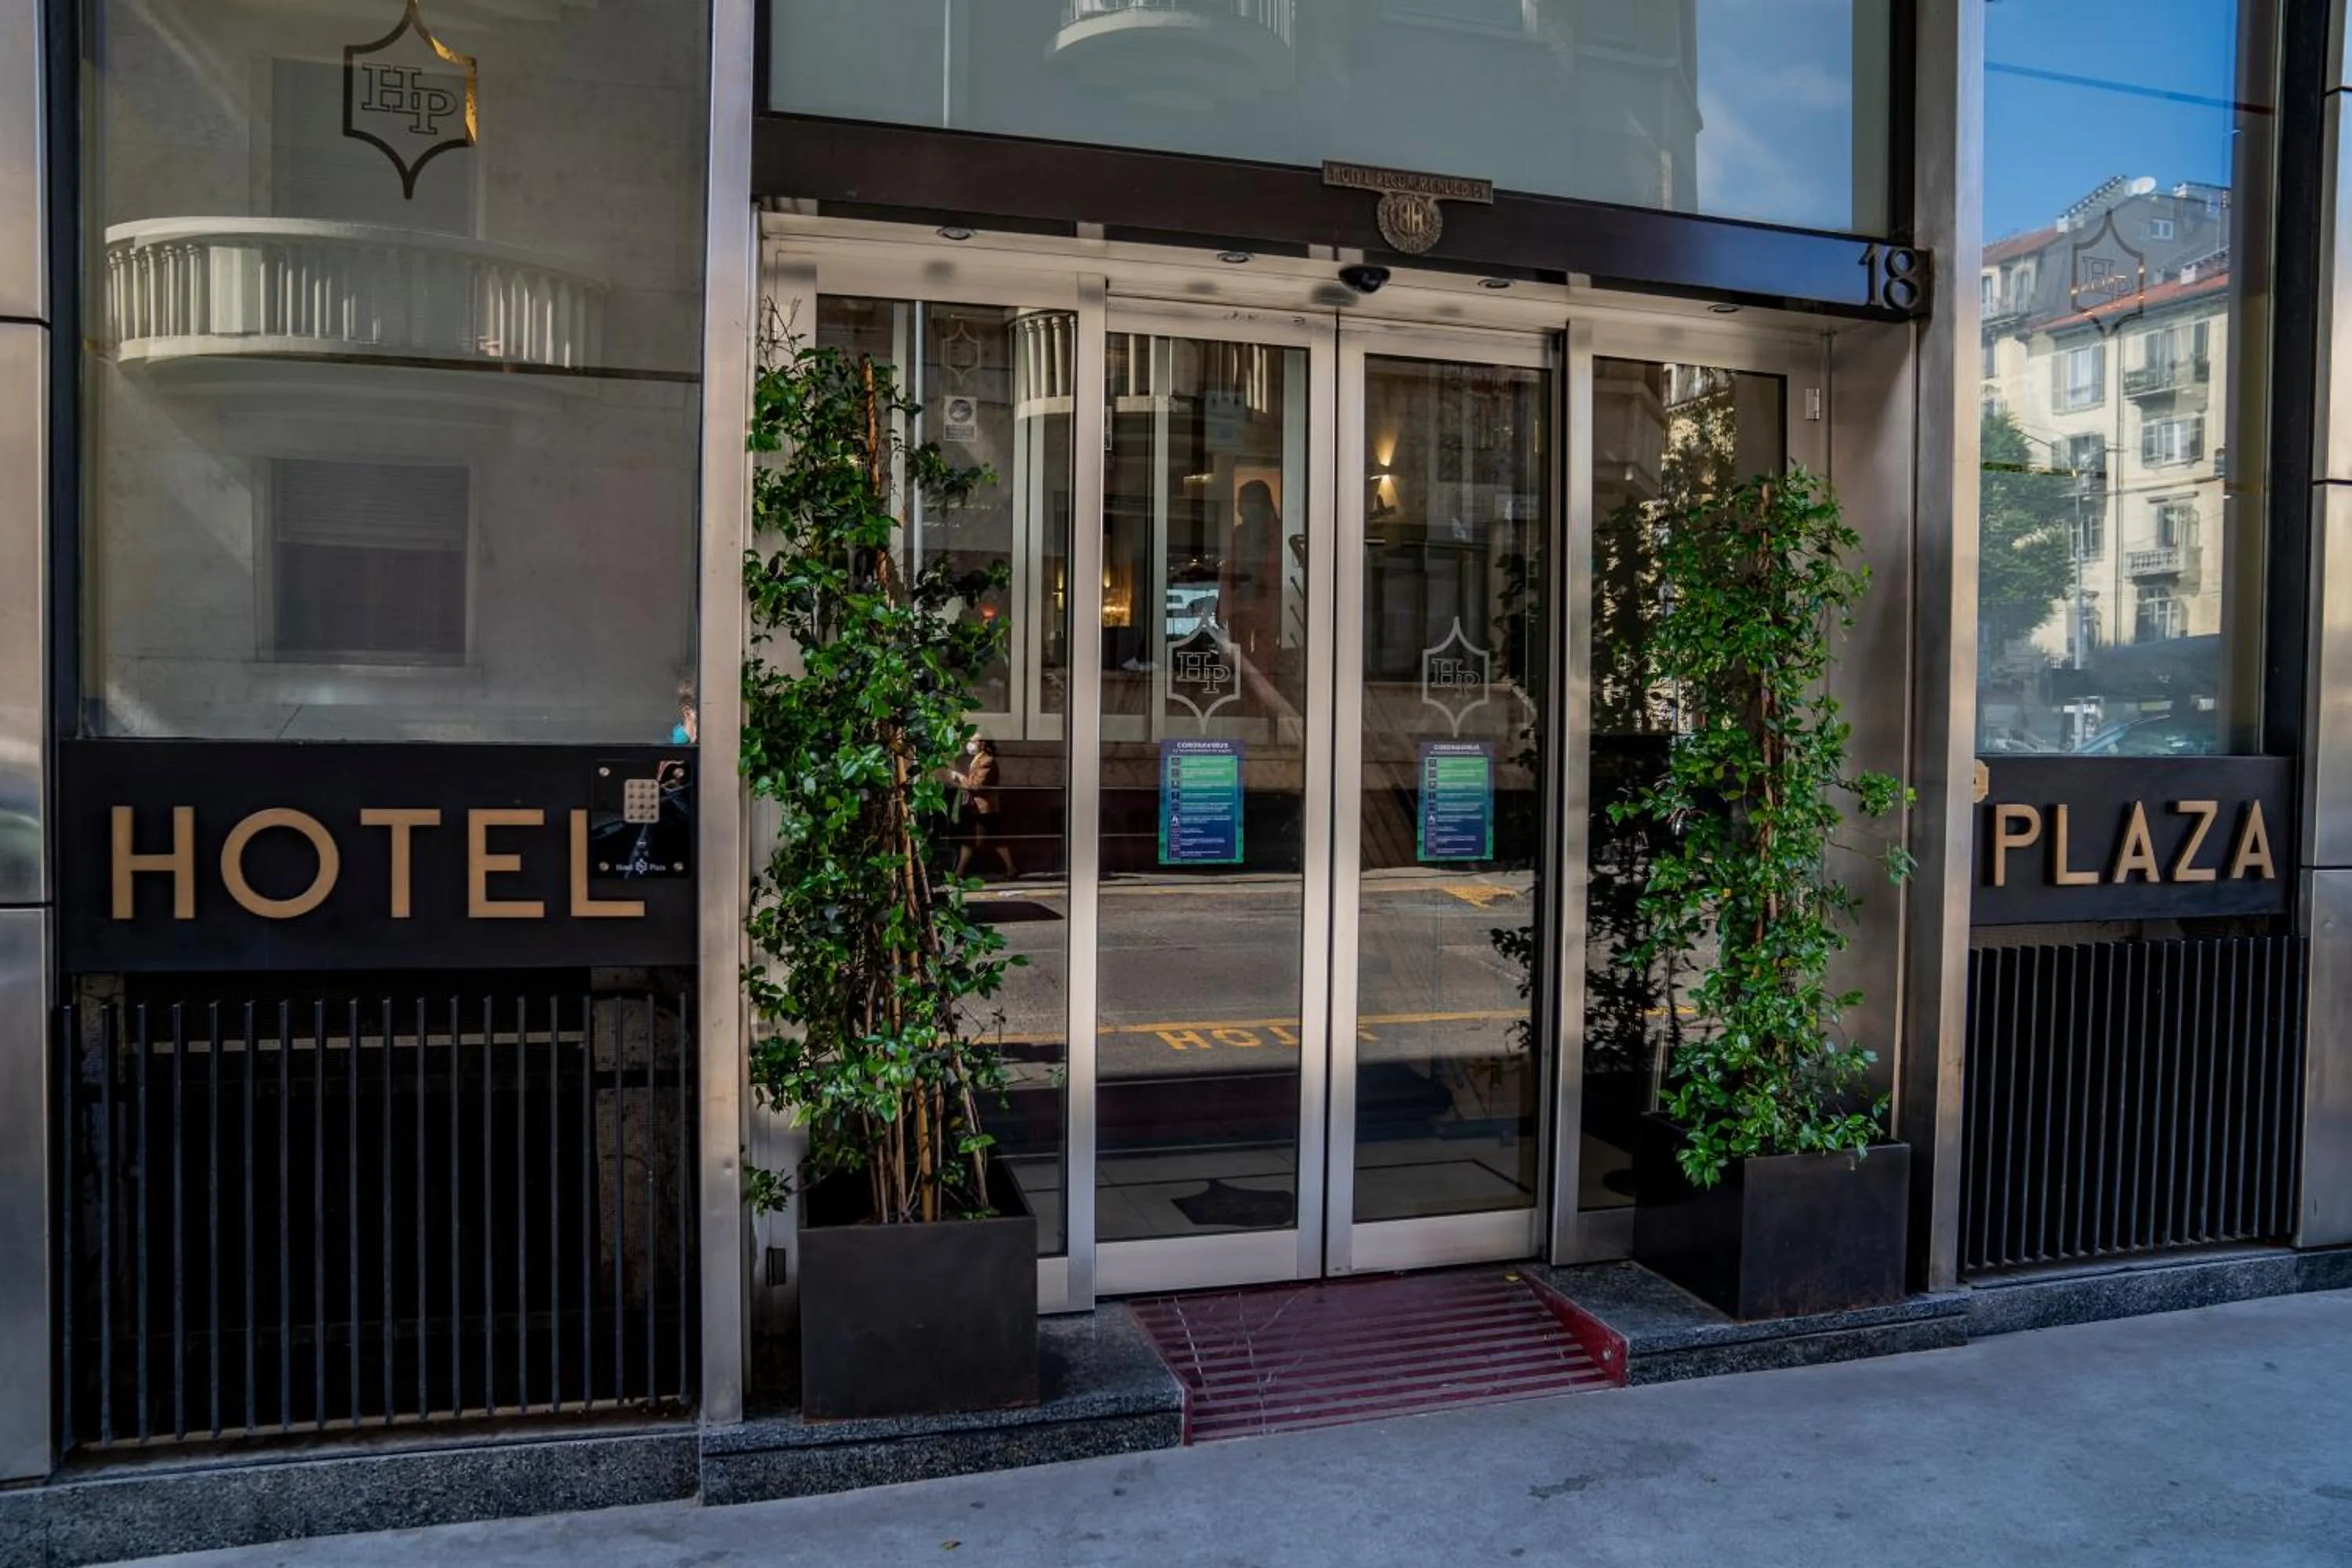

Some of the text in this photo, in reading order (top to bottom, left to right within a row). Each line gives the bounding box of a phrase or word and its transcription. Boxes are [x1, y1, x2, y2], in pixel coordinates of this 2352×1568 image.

[361, 63, 458, 135] HP
[1857, 243, 1918, 309] 18
[1177, 652, 1230, 694] HP
[112, 806, 645, 919] HOTEL
[1993, 799, 2275, 887] PLAZA
